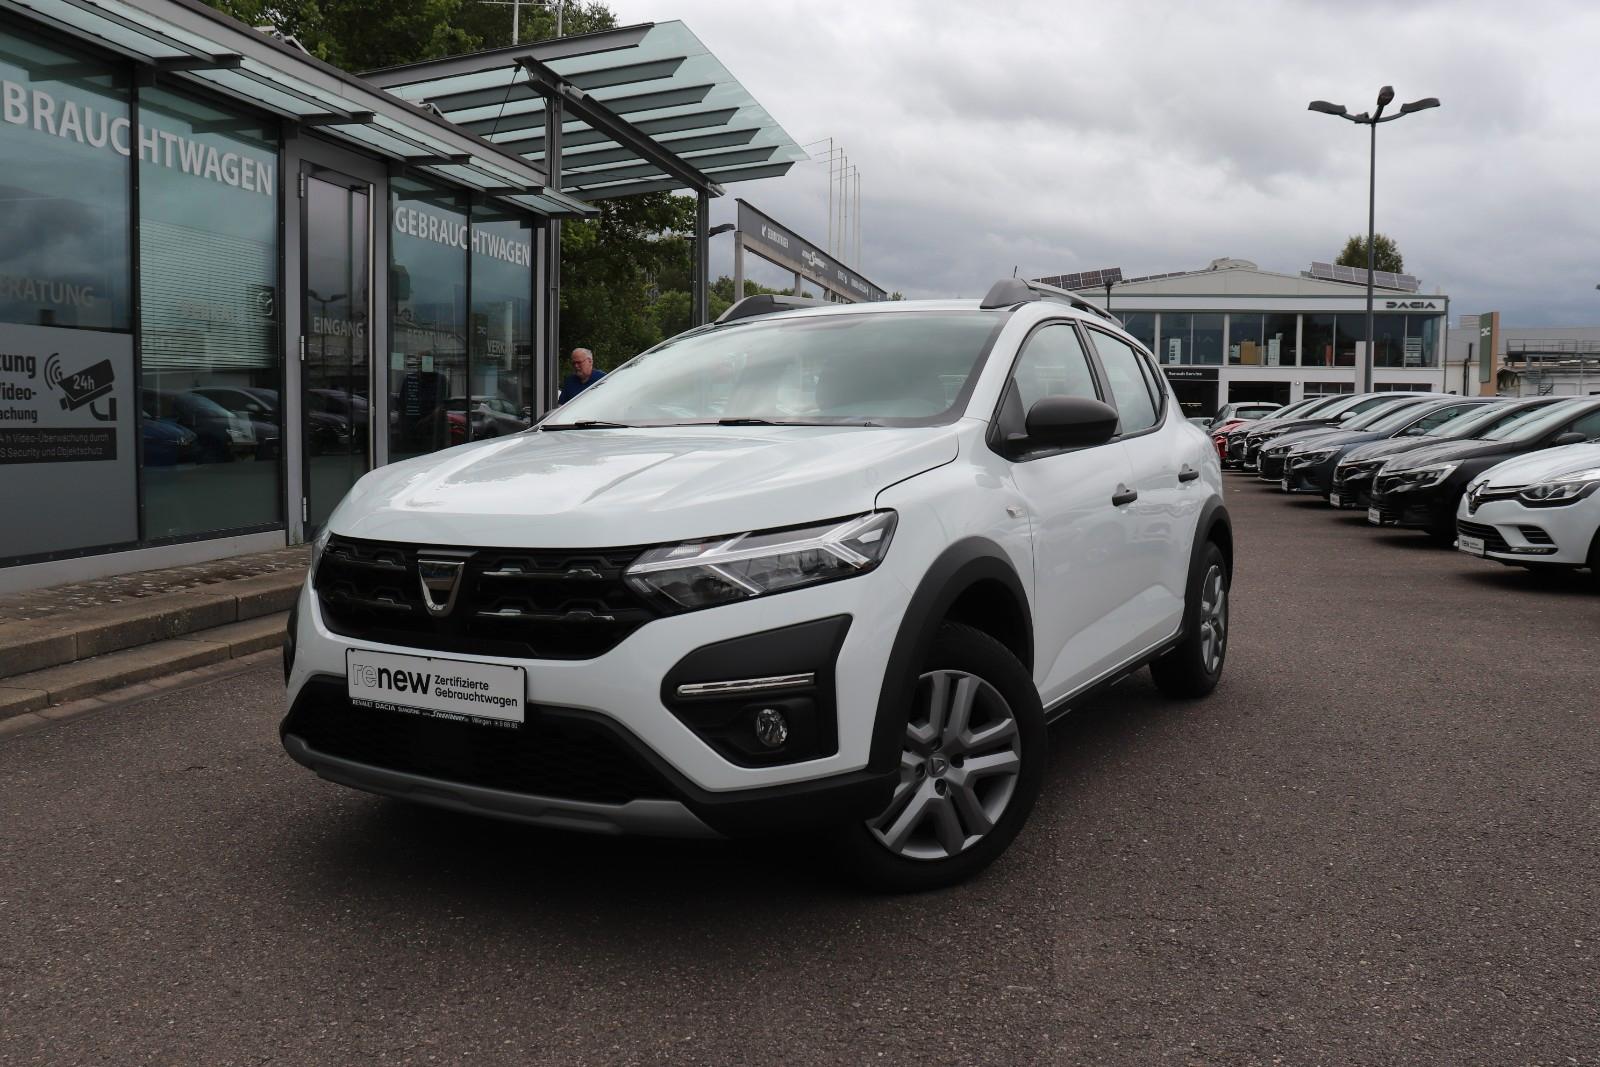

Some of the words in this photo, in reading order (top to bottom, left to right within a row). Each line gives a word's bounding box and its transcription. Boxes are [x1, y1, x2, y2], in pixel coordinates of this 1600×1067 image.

[1, 80, 273, 196] BRAUCHTWAGEN
[395, 206, 530, 267] GEBRAUCHTWAGEN
[1386, 301, 1436, 309] DACIA
[313, 316, 364, 338] EINGANG
[487, 339, 518, 354] VERKUF
[0, 353, 36, 379] ung
[73, 374, 95, 390] 24h
[353, 663, 431, 695] renew
[434, 674, 489, 691] Zertifizierte
[352, 699, 373, 708] RENAULT
[375, 702, 396, 711] DACIA
[435, 687, 518, 707] Gebrauchtwagen
